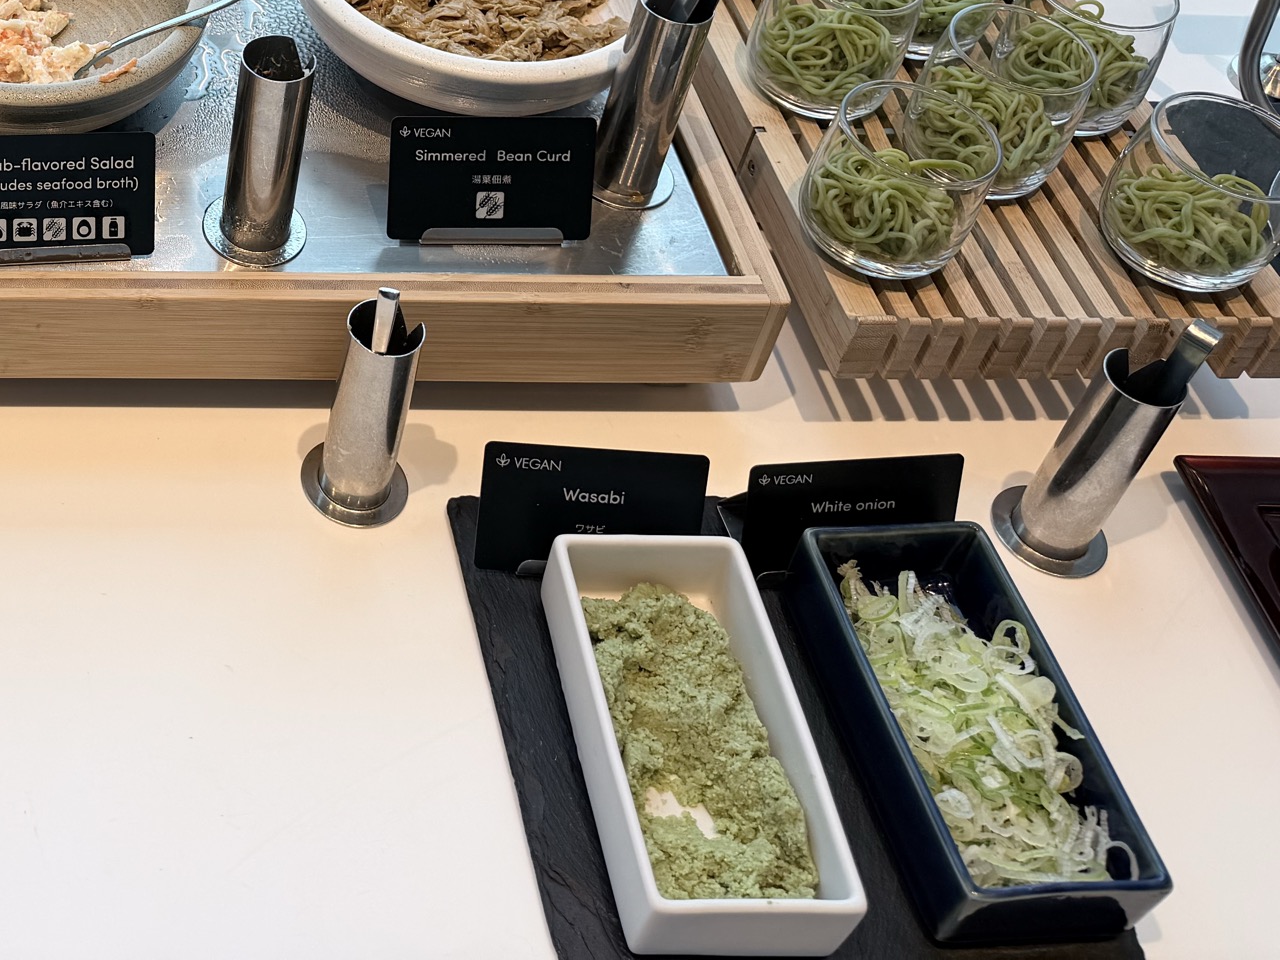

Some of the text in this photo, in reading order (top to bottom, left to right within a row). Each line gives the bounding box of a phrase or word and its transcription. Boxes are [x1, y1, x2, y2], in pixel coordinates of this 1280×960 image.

[414, 128, 451, 138] VEGAN
[415, 149, 571, 162] Simmered Bean Curd
[90, 156, 134, 170] Salad
[36, 178, 92, 190] seafood
[96, 176, 139, 191] broth)
[471, 175, 512, 184] 湯葉佃煮
[514, 457, 562, 472] VEGAN
[773, 473, 813, 485] VEGAN
[563, 487, 625, 505] Wasabi
[811, 499, 896, 513] White onion
[575, 523, 605, 534] ワサビ
